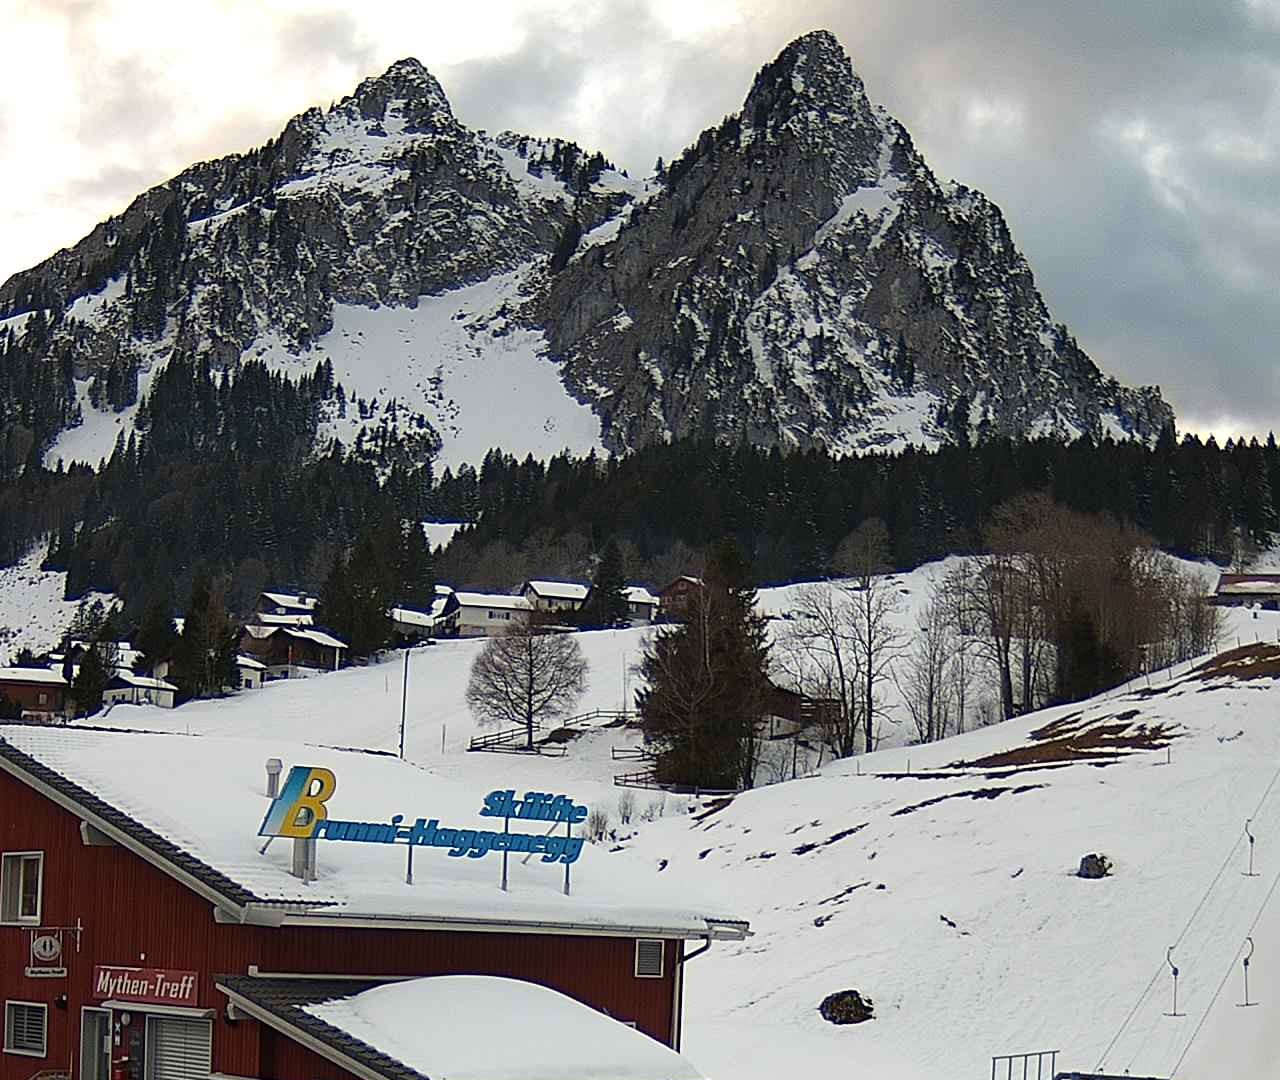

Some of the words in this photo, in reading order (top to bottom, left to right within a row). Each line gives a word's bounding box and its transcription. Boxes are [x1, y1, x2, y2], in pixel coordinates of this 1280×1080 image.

[258, 765, 585, 864] Brunni-Haggenegg
[480, 790, 588, 824] Skilifte
[96, 970, 194, 998] Mythen-Treff
